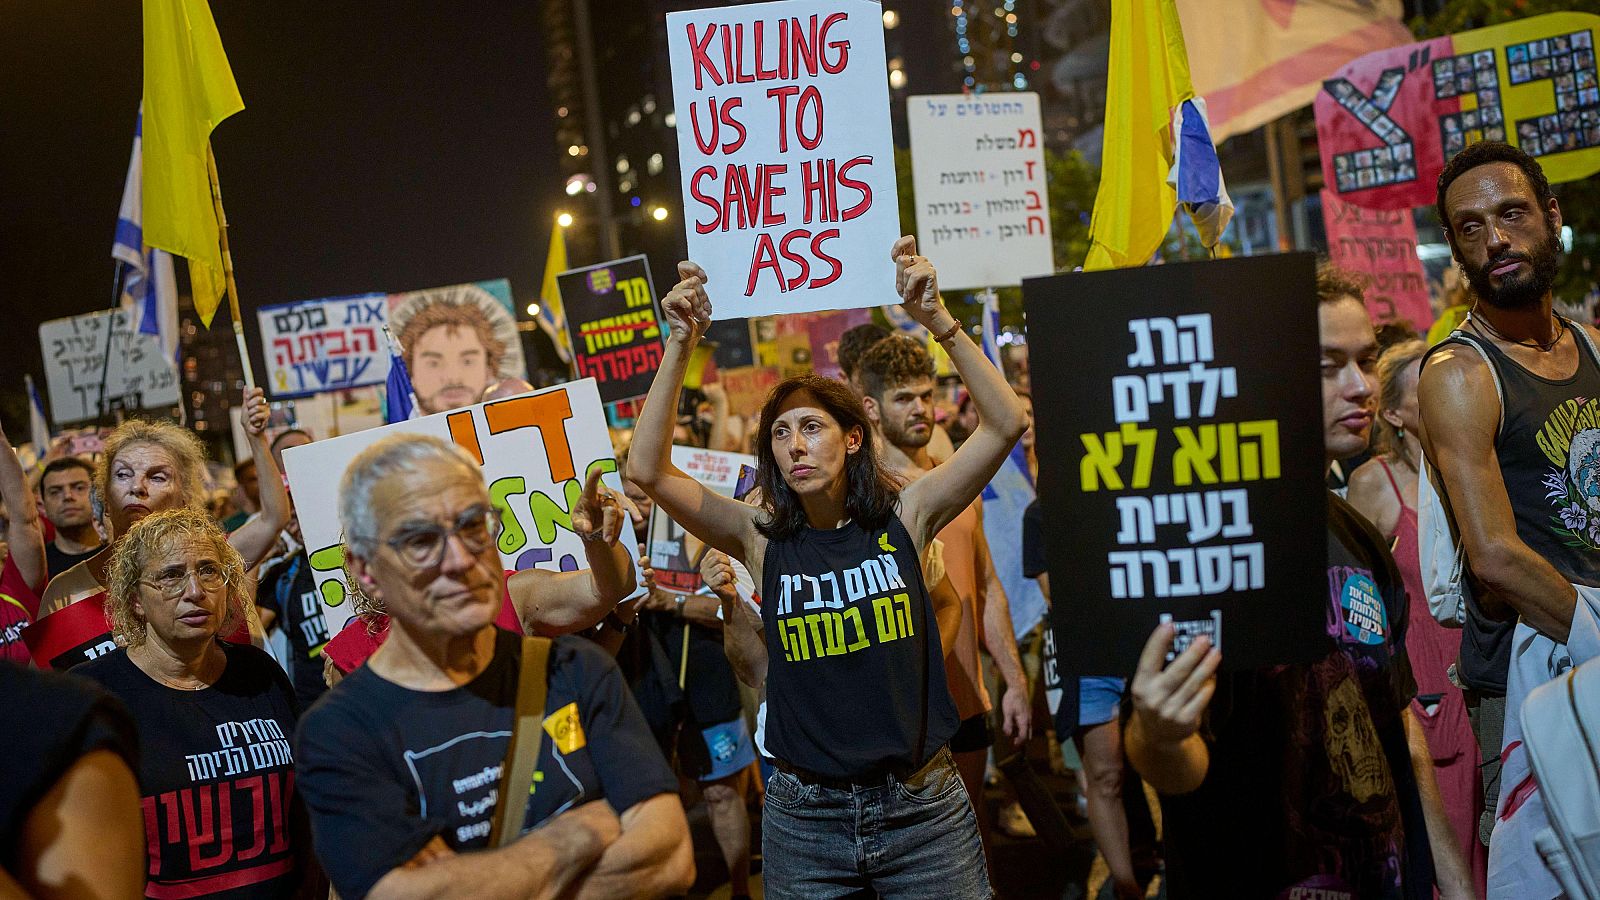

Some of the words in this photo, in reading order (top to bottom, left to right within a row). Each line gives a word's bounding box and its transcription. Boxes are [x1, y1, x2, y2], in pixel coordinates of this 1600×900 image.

[686, 12, 851, 90] KILLING
[690, 96, 747, 155] US
[767, 85, 823, 153] TO
[927, 100, 947, 116] על
[957, 103, 1023, 116] החטופים
[690, 163, 787, 234] SAVE
[800, 155, 873, 223] HIS
[744, 229, 842, 297] ASS
[344, 302, 384, 325] את
[615, 276, 651, 308] מר
[273, 327, 377, 367] הביתה
[577, 341, 663, 382] הפקרה!
[1127, 313, 1214, 368] הרג
[292, 357, 371, 389] עכשיו
[1112, 362, 1238, 424] ילדים
[1080, 422, 1158, 492] לא
[1172, 420, 1281, 486] הוא
[1535, 399, 1578, 469] WILD
[1116, 489, 1253, 544] בעיית
[777, 571, 844, 615] בבית
[843, 553, 907, 602] אתם
[1108, 542, 1265, 599] הסברה
[777, 606, 871, 662] בעזה!
[872, 592, 914, 643] הם
[216, 718, 285, 749] מחזירים
[249, 740, 294, 770] אותם
[185, 747, 249, 781] הביתה
